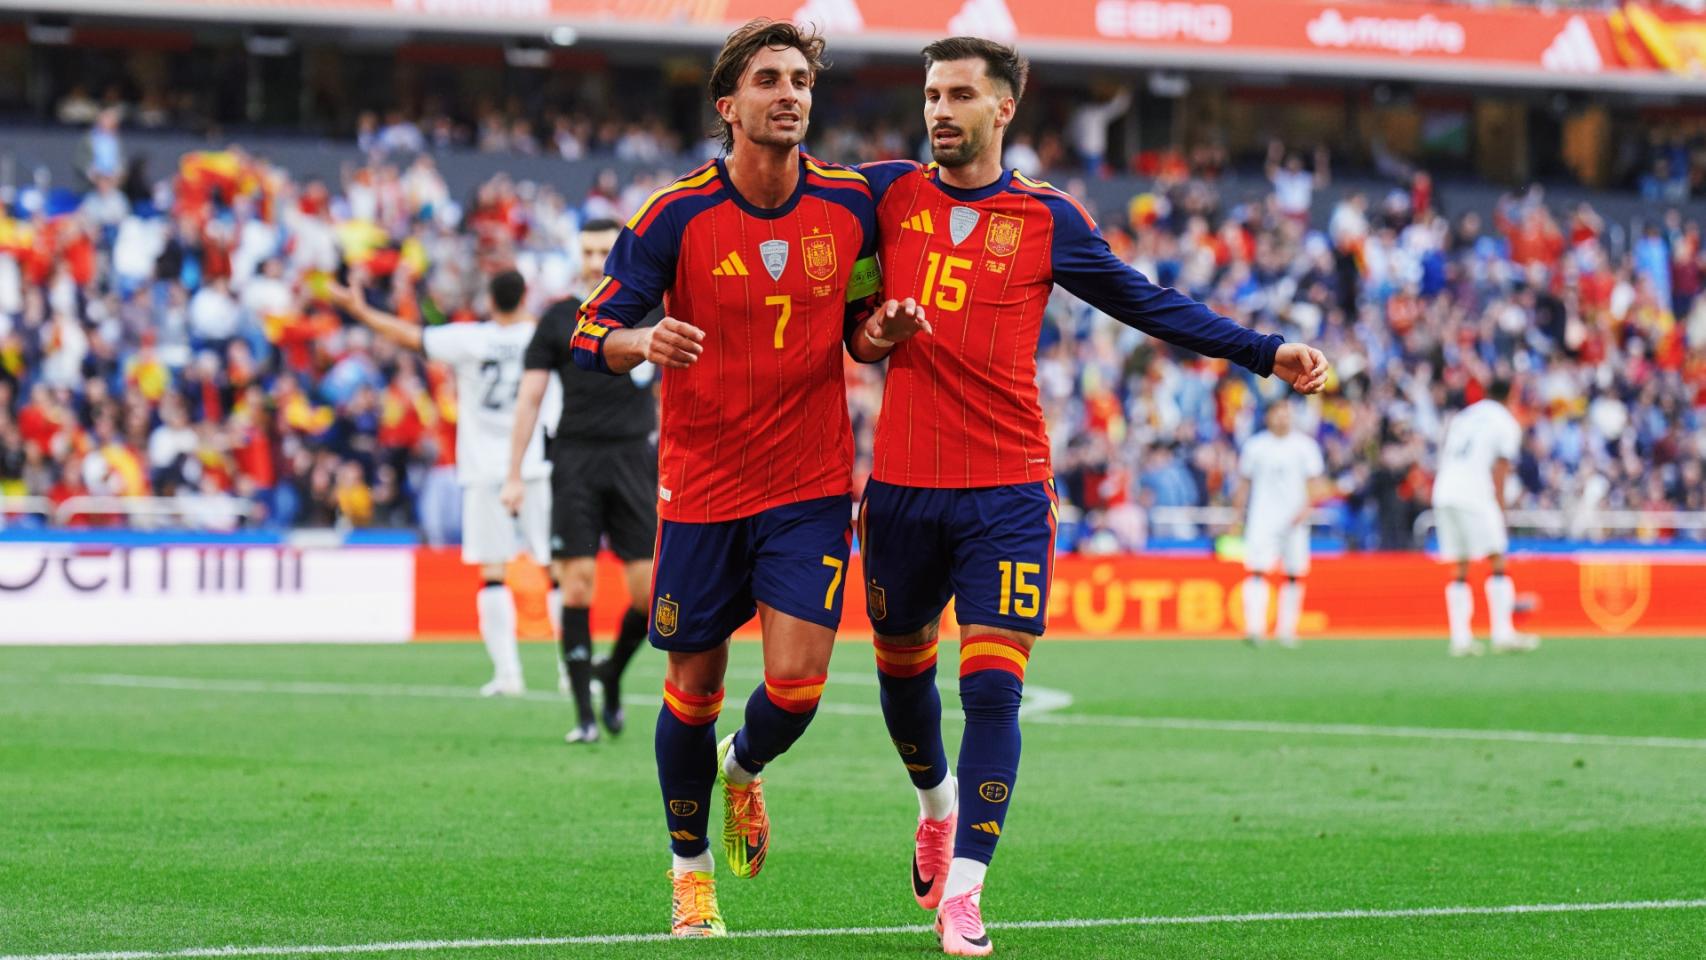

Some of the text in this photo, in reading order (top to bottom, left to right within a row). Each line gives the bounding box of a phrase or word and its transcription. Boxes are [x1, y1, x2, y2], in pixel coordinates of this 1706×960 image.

[921, 252, 972, 311] 15
[765, 295, 791, 348] 7
[822, 555, 843, 610] 7
[998, 561, 1040, 618] 15
